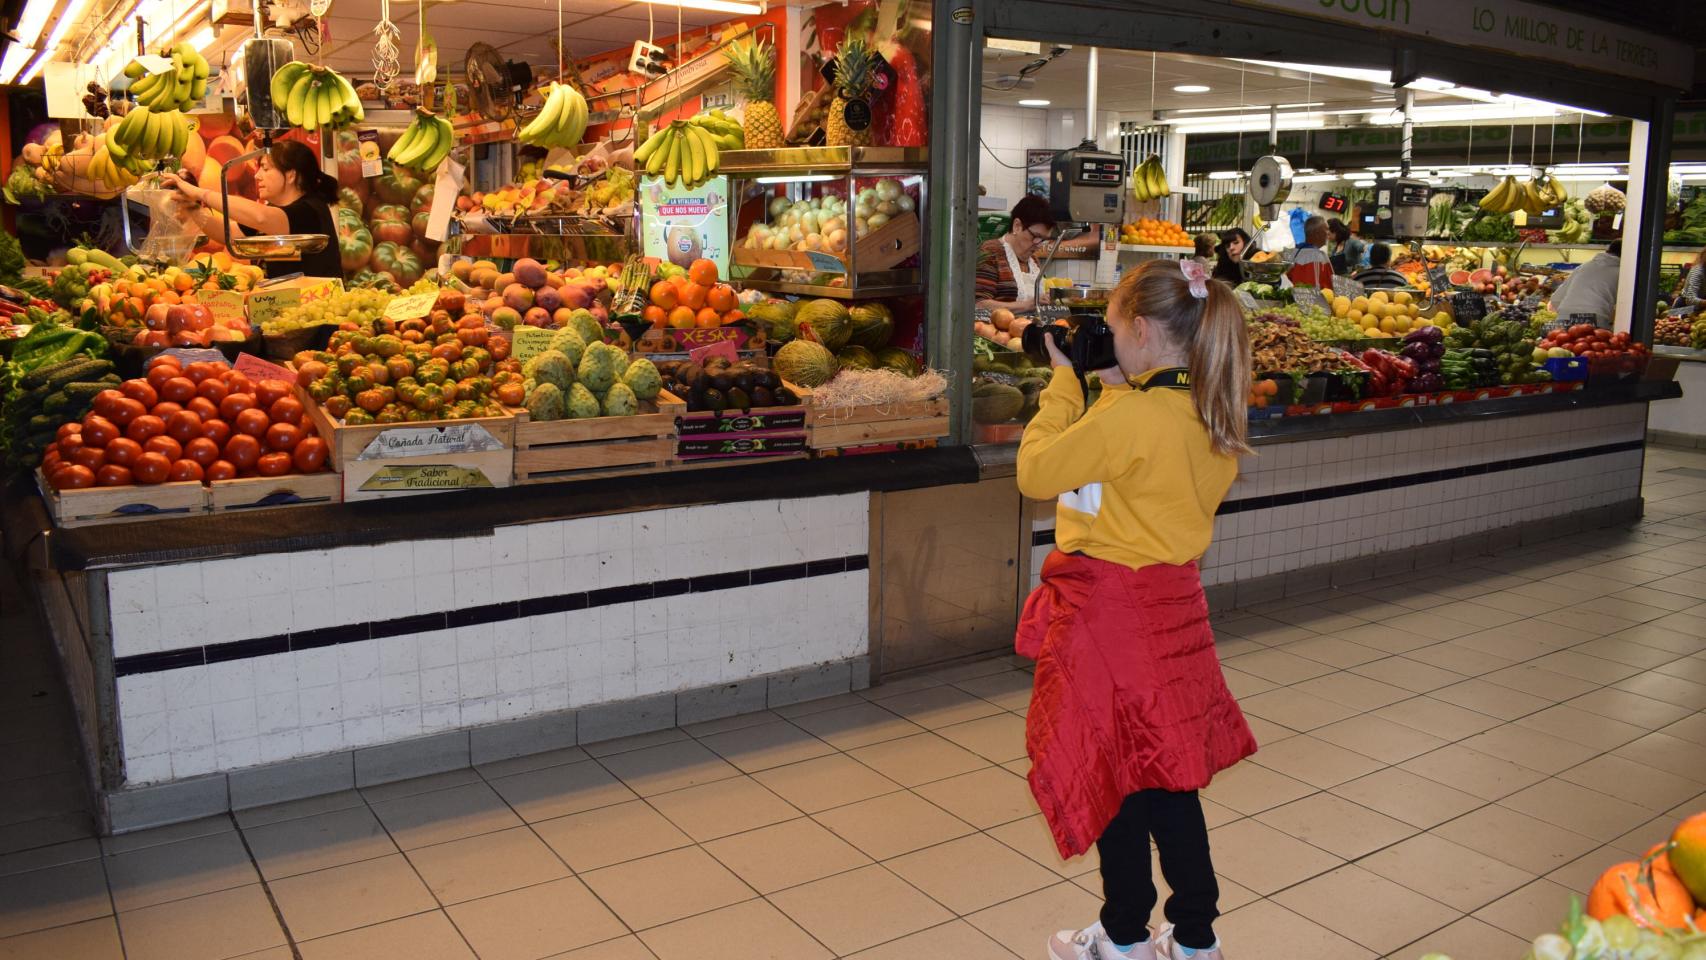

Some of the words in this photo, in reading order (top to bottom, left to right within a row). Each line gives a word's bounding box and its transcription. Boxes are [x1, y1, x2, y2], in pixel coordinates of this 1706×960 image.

[1473, 6, 1496, 33] LO
[1504, 15, 1558, 46] MILLOR
[1566, 27, 1584, 51] DE
[1591, 32, 1609, 56] LA
[1616, 39, 1659, 70] TERRETA
[662, 206, 674, 214] QUE
[675, 206, 687, 214] NOS
[688, 206, 708, 214] MUEVE
[1323, 196, 1344, 211] 37
[388, 435, 424, 449] Cañada
[427, 431, 466, 445] Natural
[420, 467, 449, 478] Sabor
[406, 477, 460, 488] Tradicional
